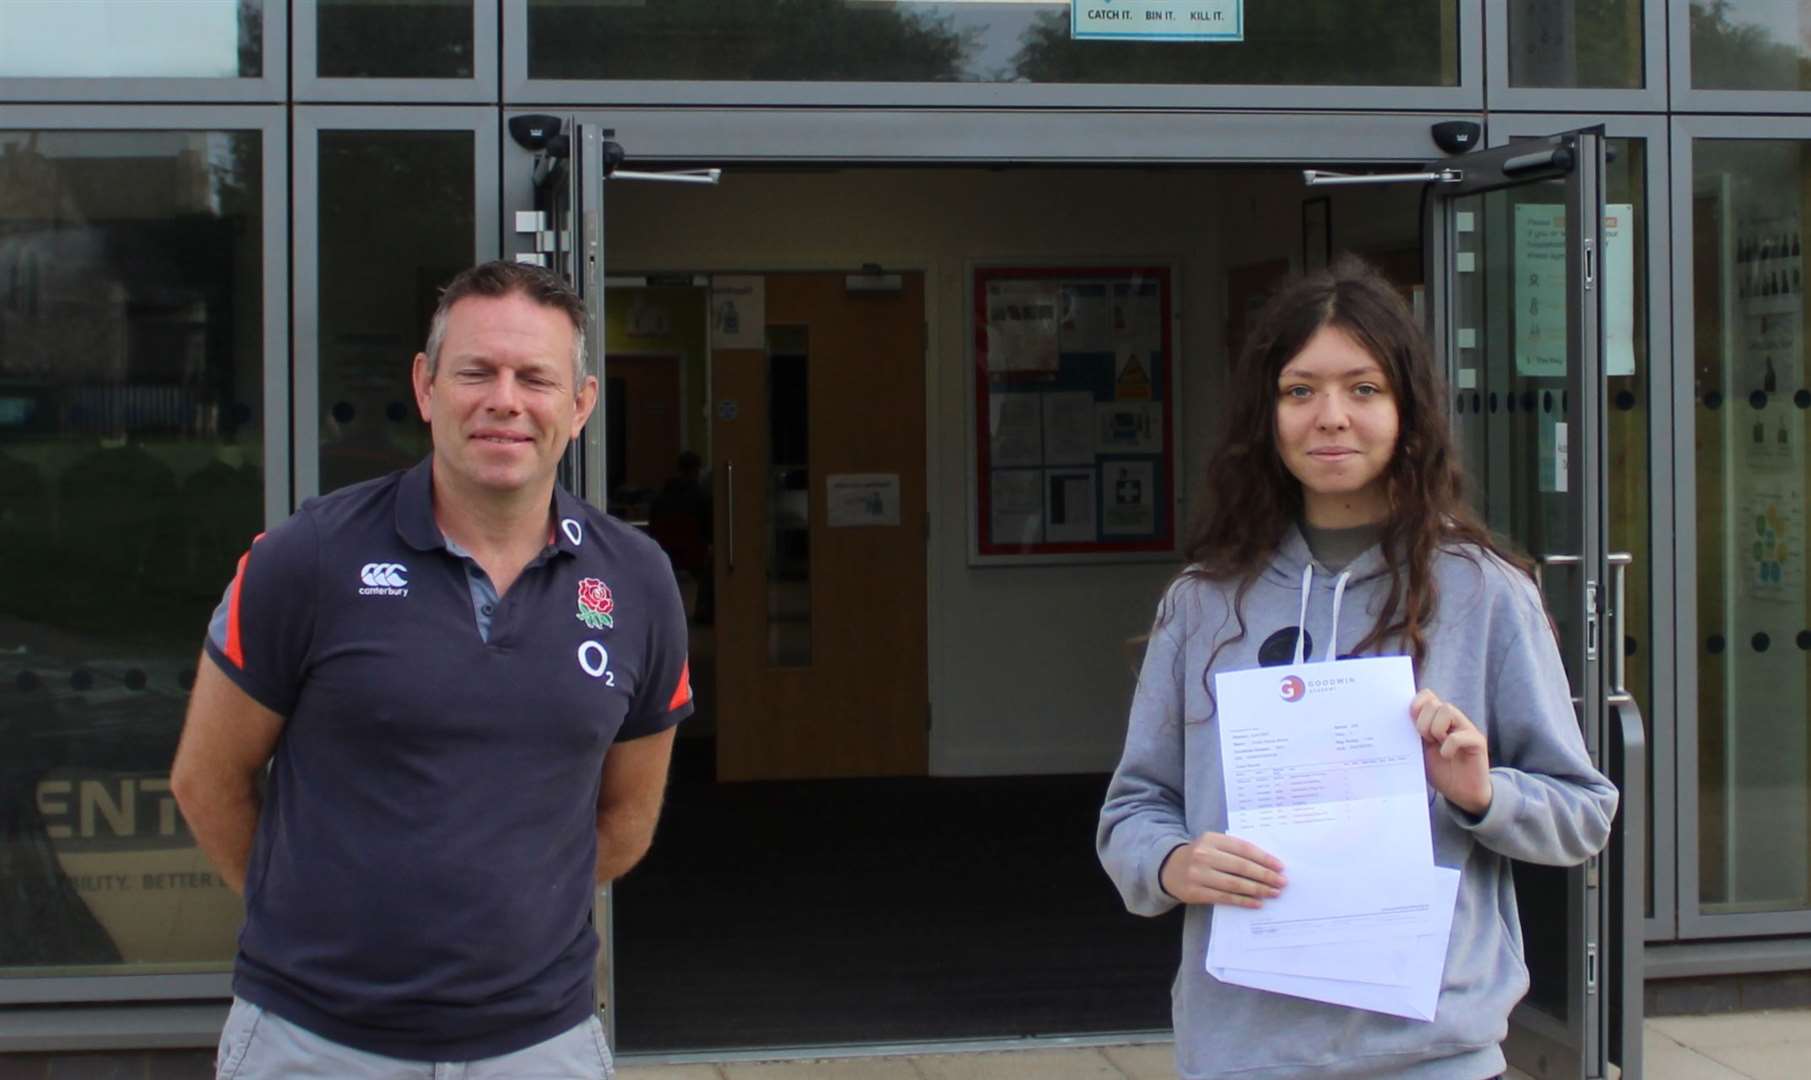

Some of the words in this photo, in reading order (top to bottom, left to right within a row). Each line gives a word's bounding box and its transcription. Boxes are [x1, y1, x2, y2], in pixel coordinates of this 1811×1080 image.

[1087, 9, 1120, 21] CATCH
[1121, 10, 1133, 21] IT.
[1145, 10, 1163, 21] BIN
[1165, 11, 1176, 21] IT.
[1190, 11, 1210, 21] KILL
[1213, 11, 1225, 21] IT.
[358, 586, 409, 597] canterbury
[1307, 676, 1356, 688] GOODWIN
[142, 871, 211, 890] BETTER
